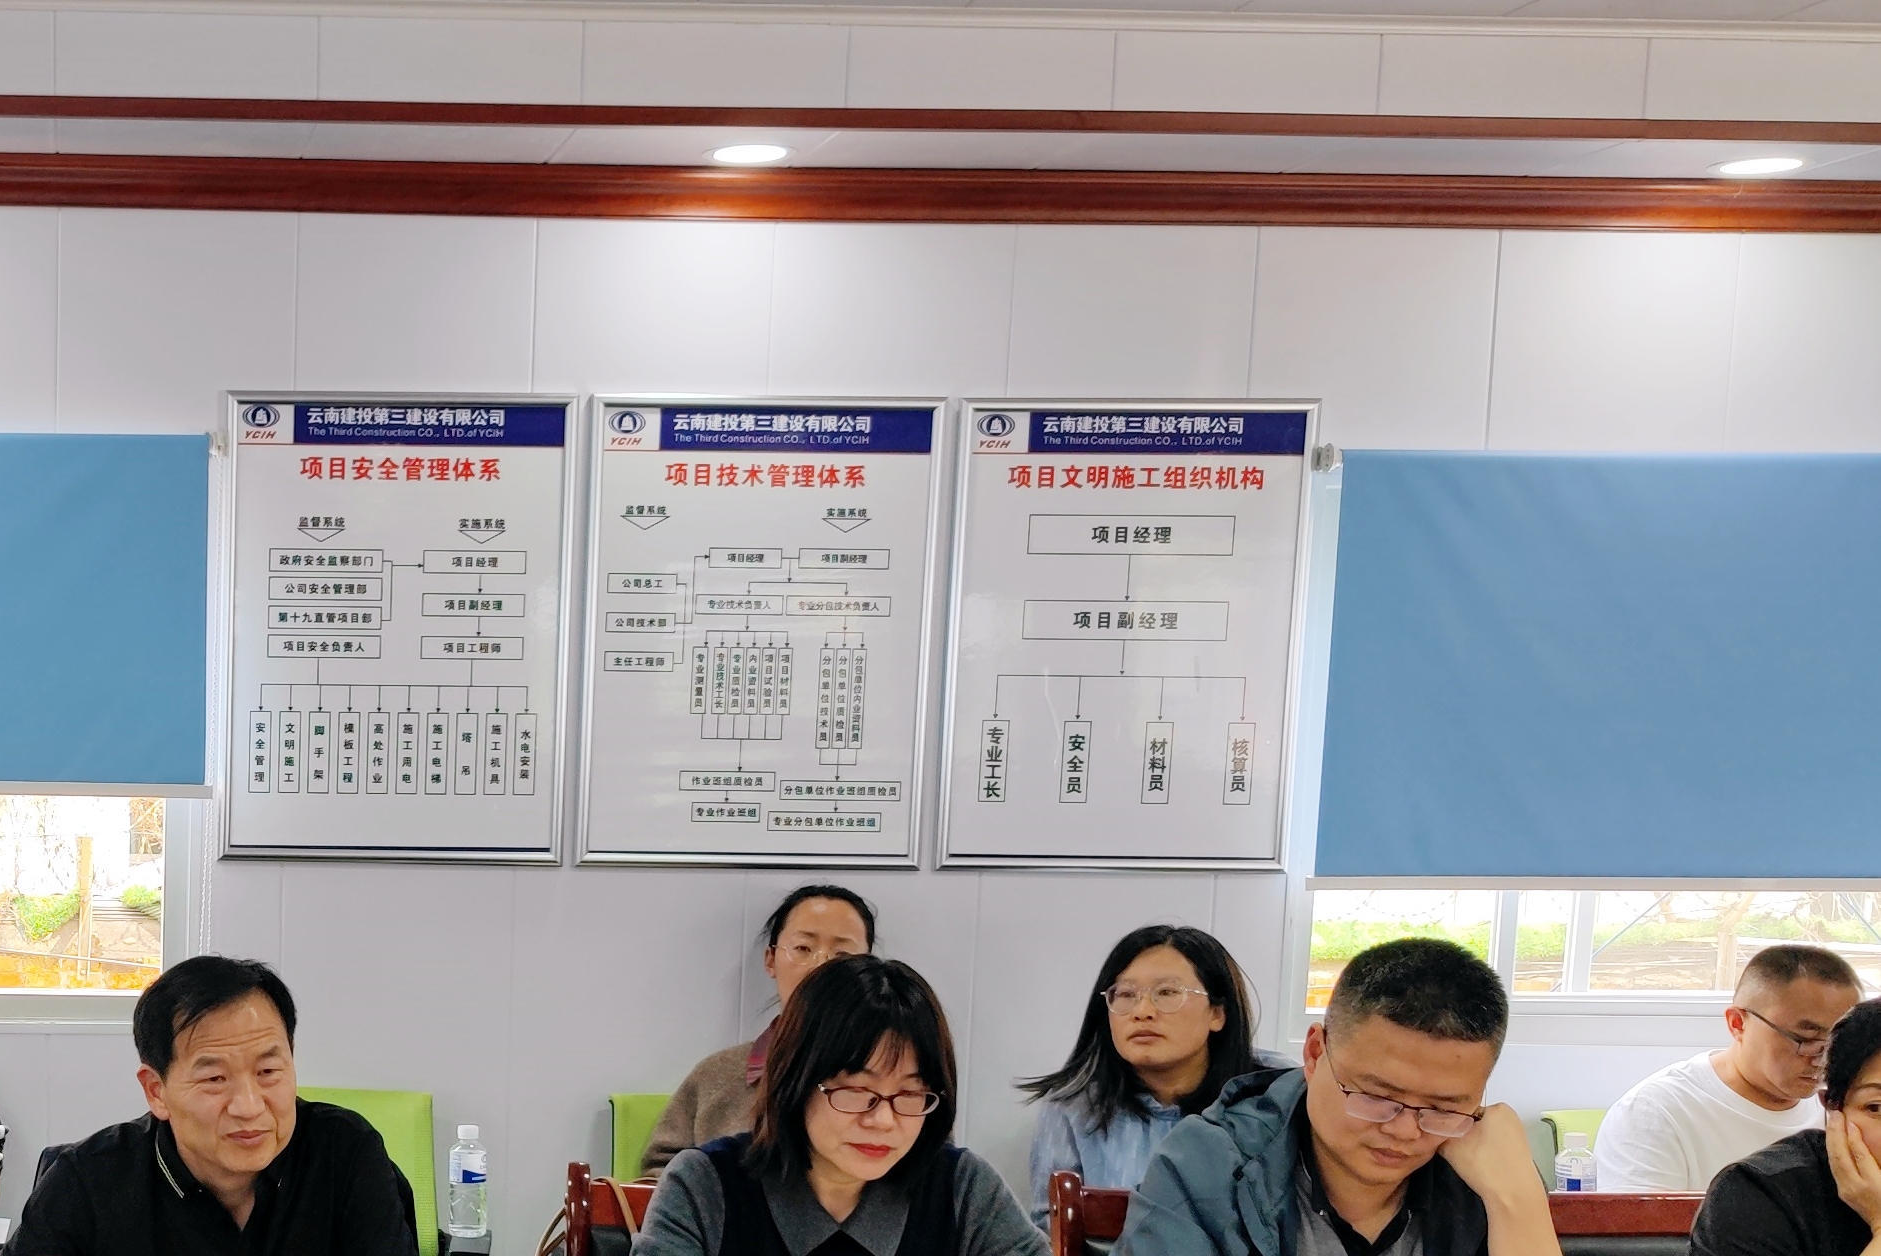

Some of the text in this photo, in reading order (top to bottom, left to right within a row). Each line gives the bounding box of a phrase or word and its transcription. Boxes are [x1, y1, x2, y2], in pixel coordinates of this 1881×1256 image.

[307, 407, 505, 426] 云南建投第三建设有限公司
[673, 414, 871, 433] 云南建投第三建设有限公司
[1043, 416, 1244, 434] 云南建投第三建设有限公司
[245, 431, 276, 439] YCIH
[308, 426, 326, 438] The
[329, 426, 352, 438] Third
[354, 426, 416, 438] Construction
[478, 426, 504, 438] YCIH
[674, 433, 692, 445] The
[695, 433, 718, 445] Third
[720, 433, 781, 445] Construction
[844, 433, 870, 445] YCIH
[980, 440, 1011, 448] YCIH
[1043, 435, 1061, 446] The
[1065, 435, 1090, 446] Third
[1091, 435, 1153, 446] Construction
[1217, 435, 1242, 446] YCIH
[301, 456, 500, 481] 项目安全管理体系
[665, 463, 864, 488] 项目技术管理体系
[1008, 465, 1264, 490] 项目文明施工组织机构
[625, 506, 666, 515] 监督系统
[827, 508, 867, 517] 实施系统
[299, 517, 345, 527] 监督系统
[459, 519, 505, 529] 实施系统
[1092, 526, 1171, 543] 项目经理
[280, 555, 373, 566] 政府安全监察部门
[452, 557, 498, 567] 项目经理
[728, 554, 764, 562] 项目经理
[821, 554, 867, 563] 项目副经理
[285, 583, 366, 594] 公司安全管理部
[622, 579, 662, 588] 公司总工
[445, 600, 502, 610] 项目副经理
[708, 600, 770, 609] 专业技术负责人
[278, 613, 372, 623] 第十九直管项目部
[615, 618, 666, 627] 公司技术部
[1073, 612, 1177, 629] 项目副经理
[283, 641, 364, 652] 项目安全负责人
[443, 643, 501, 653] 项目工程师
[614, 657, 664, 666] 主任工程师
[255, 723, 265, 782] 安全管理
[284, 723, 295, 782] 文明施工
[314, 726, 324, 779] 脚手架
[343, 723, 354, 782] 模板工程
[372, 724, 384, 783] 高处作业
[402, 724, 413, 783] 施工用电
[431, 725, 442, 783] 施工电梯
[490, 725, 501, 784] 施工机具
[520, 731, 531, 779] 水电安装
[982, 727, 1005, 798] 专业工长
[1066, 734, 1085, 793] 安全员
[1148, 739, 1169, 791] 材料员
[1230, 739, 1249, 792] 核算员
[692, 777, 763, 786] 作业班组质检员
[696, 808, 756, 817] 专业作业班组
[773, 817, 875, 827] 专业分包单位作业班组
